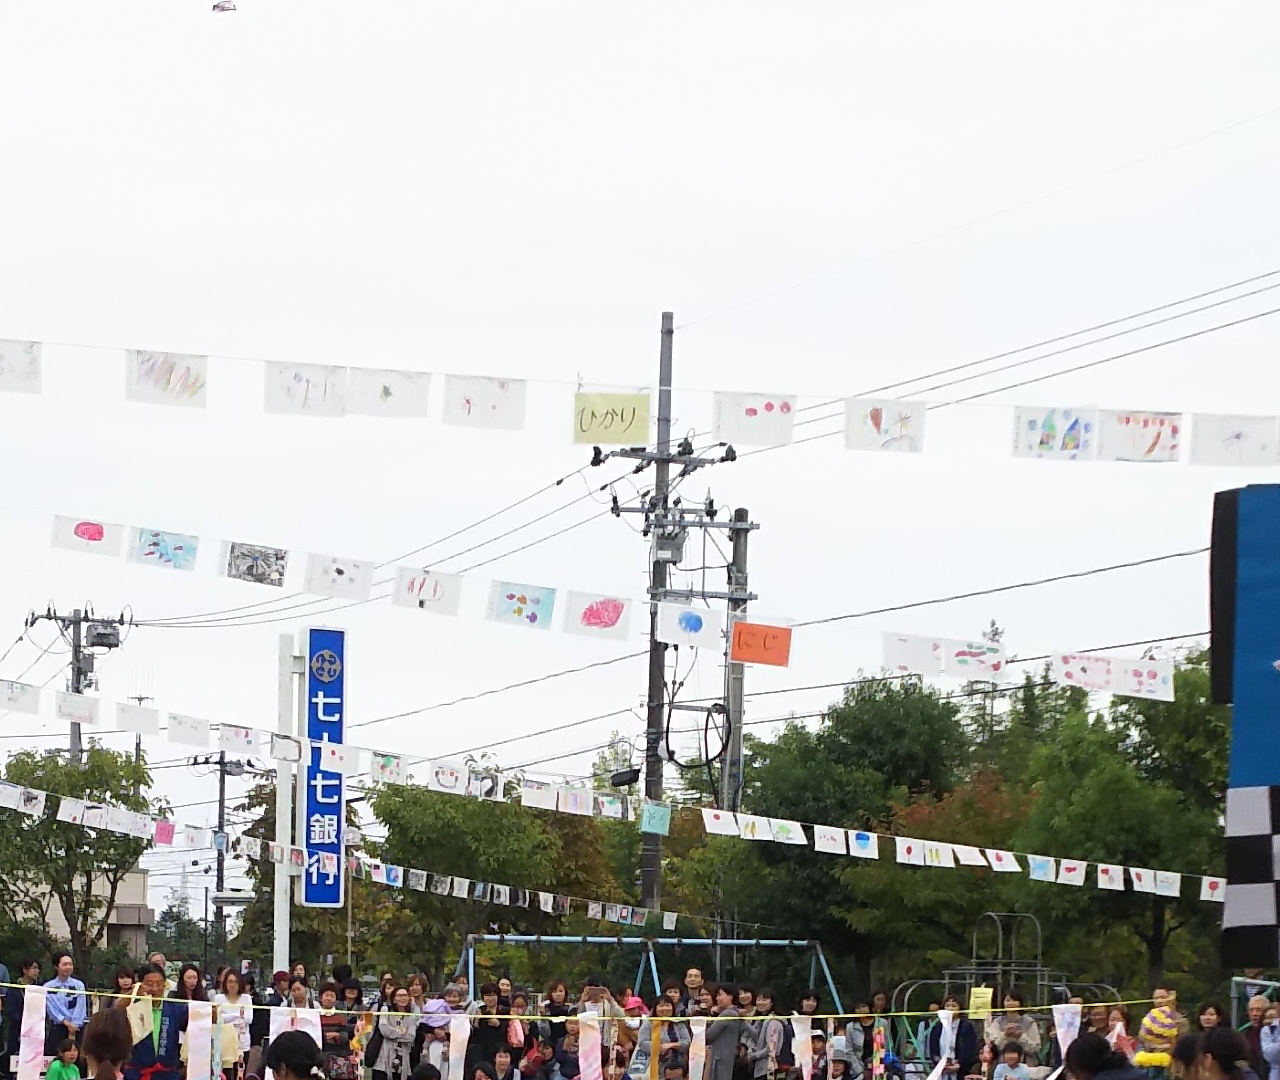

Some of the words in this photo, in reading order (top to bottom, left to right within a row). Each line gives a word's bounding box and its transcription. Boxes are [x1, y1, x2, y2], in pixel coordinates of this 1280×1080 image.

[577, 406, 636, 433] ひかり
[737, 629, 779, 651] にじ
